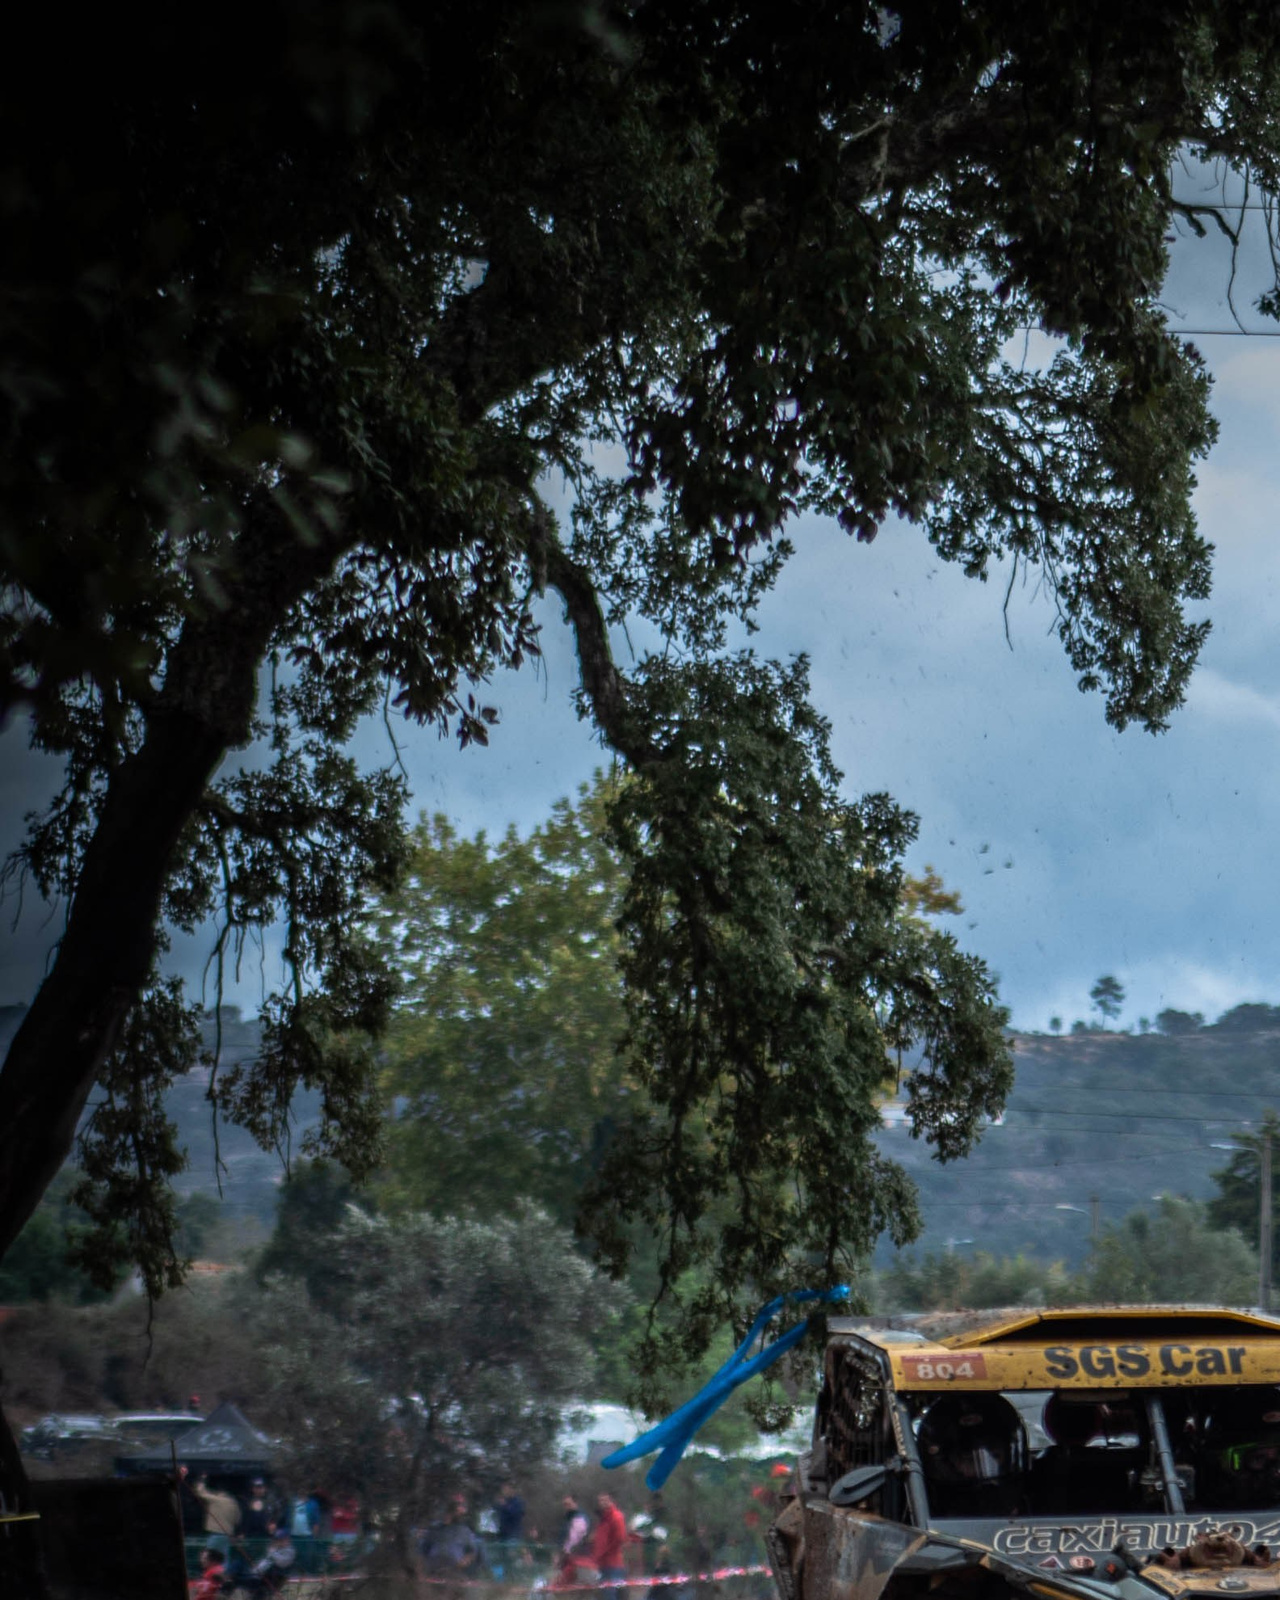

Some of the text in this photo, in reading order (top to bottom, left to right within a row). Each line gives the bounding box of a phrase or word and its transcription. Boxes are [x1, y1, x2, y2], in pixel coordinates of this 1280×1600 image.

[917, 1362, 975, 1379] 804
[1044, 1344, 1246, 1379] SGS Car
